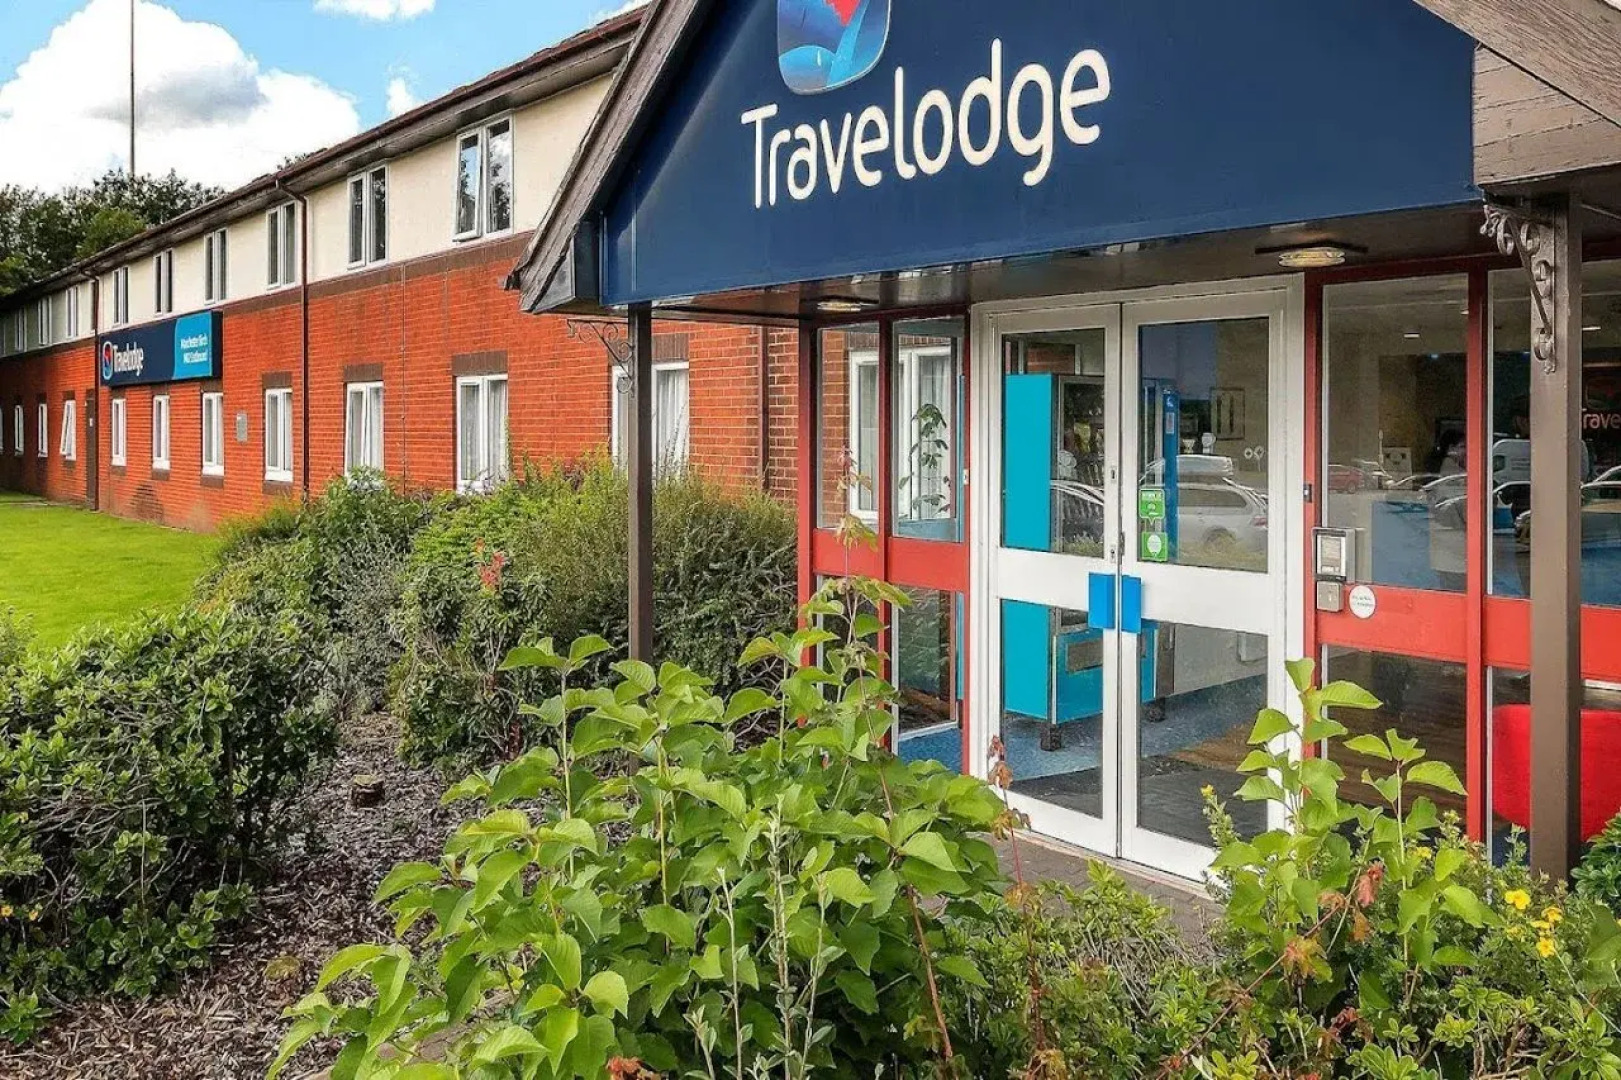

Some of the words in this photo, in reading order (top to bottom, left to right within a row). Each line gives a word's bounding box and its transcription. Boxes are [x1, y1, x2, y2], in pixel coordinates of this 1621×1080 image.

[740, 37, 1111, 209] Travelodge
[112, 341, 144, 377] Travelodge
[1582, 408, 1621, 429] rave
